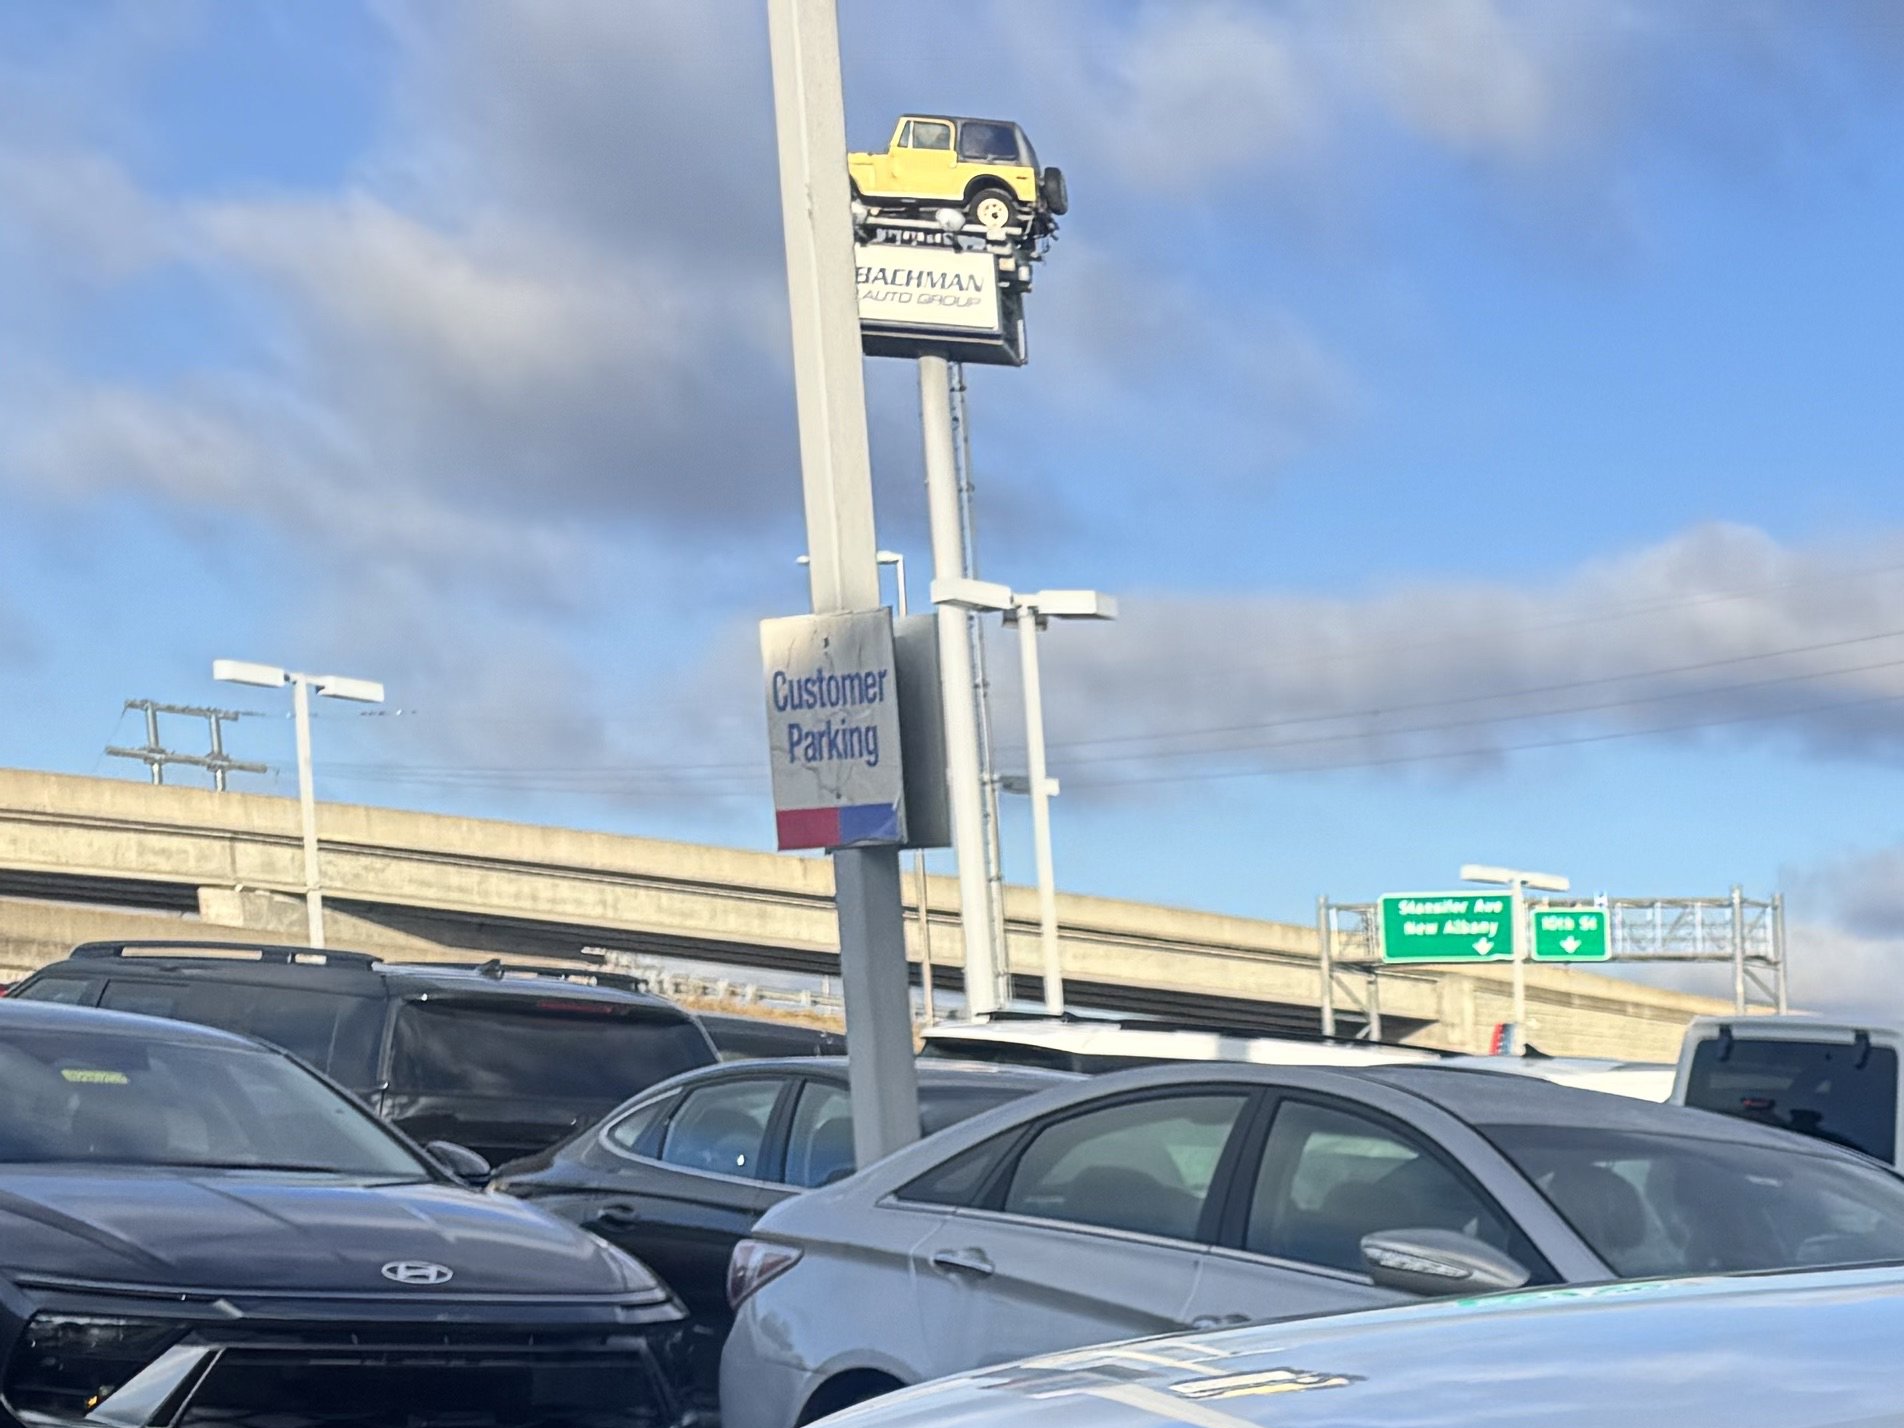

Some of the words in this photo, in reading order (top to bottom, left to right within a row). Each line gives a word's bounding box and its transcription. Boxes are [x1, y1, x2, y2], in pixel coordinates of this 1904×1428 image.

[856, 266, 984, 292] BACHMAN
[863, 290, 912, 303] AUTO
[917, 293, 982, 307] GROUP
[773, 667, 888, 712] Customer
[788, 719, 880, 767] Parking
[1403, 921, 1438, 935] New
[1443, 919, 1499, 938] Albany
[1579, 916, 1598, 931] St
